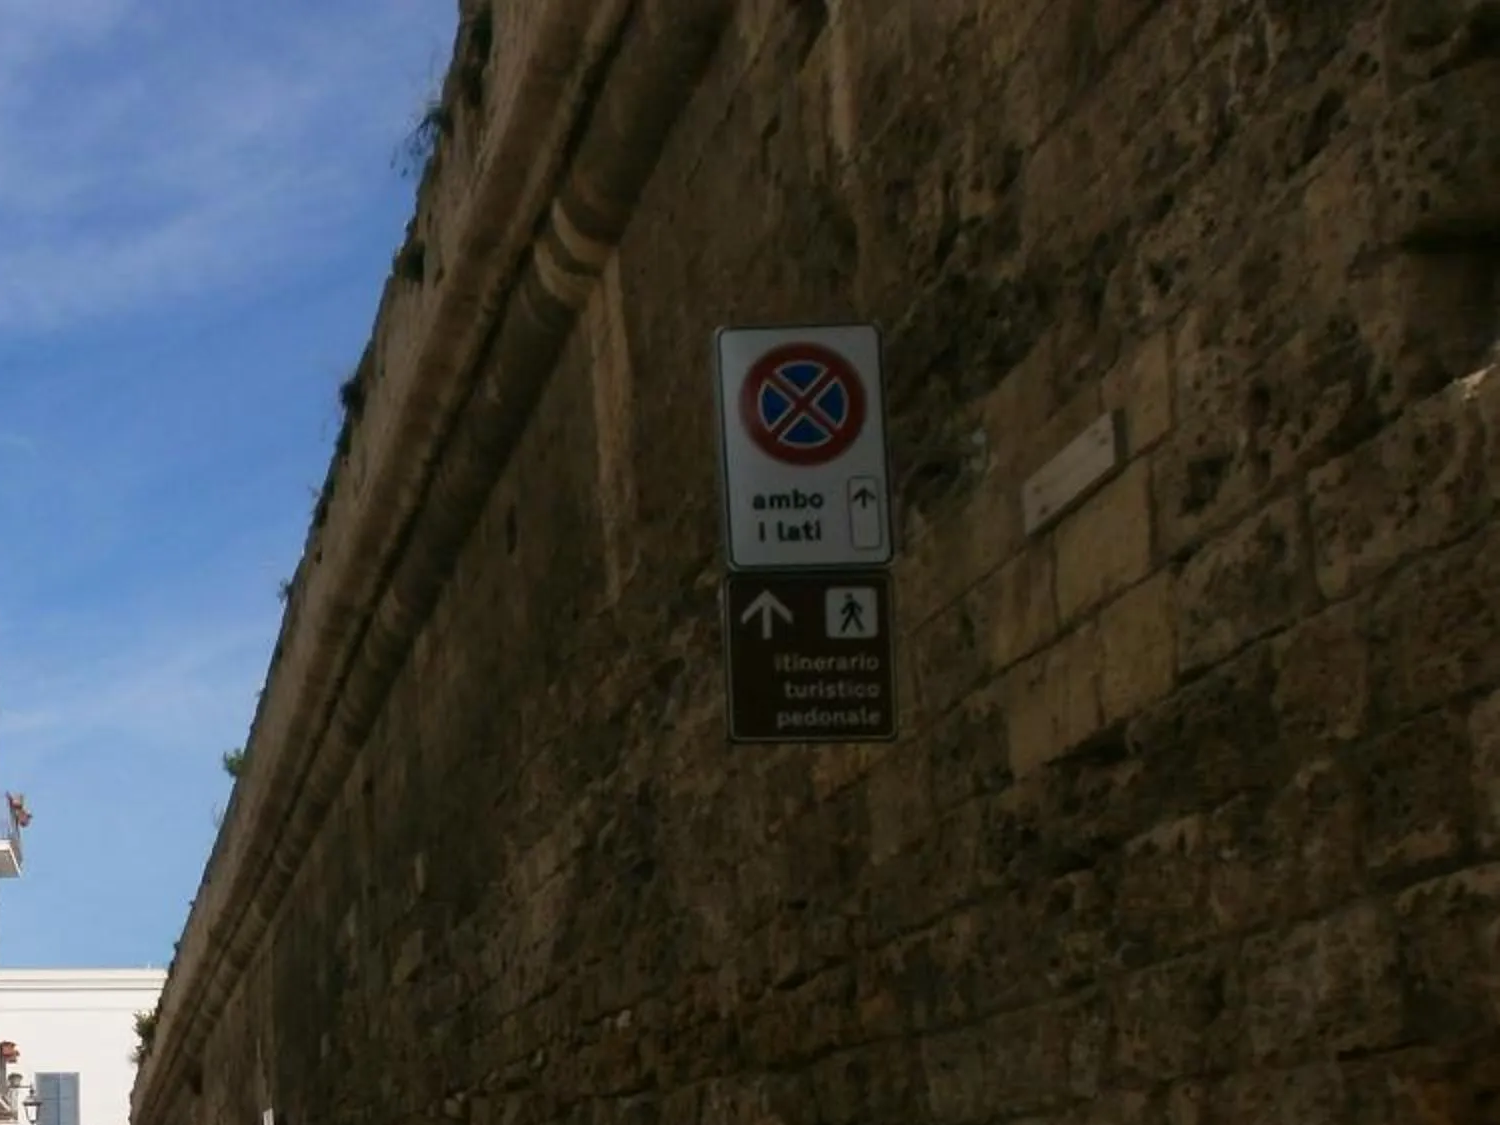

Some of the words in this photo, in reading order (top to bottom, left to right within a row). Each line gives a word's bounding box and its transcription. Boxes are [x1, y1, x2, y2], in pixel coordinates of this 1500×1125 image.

[752, 488, 824, 510] ambo
[777, 519, 821, 542] lati
[774, 650, 880, 671] itinerario
[784, 678, 880, 699] turistico
[776, 705, 880, 729] pedonale
